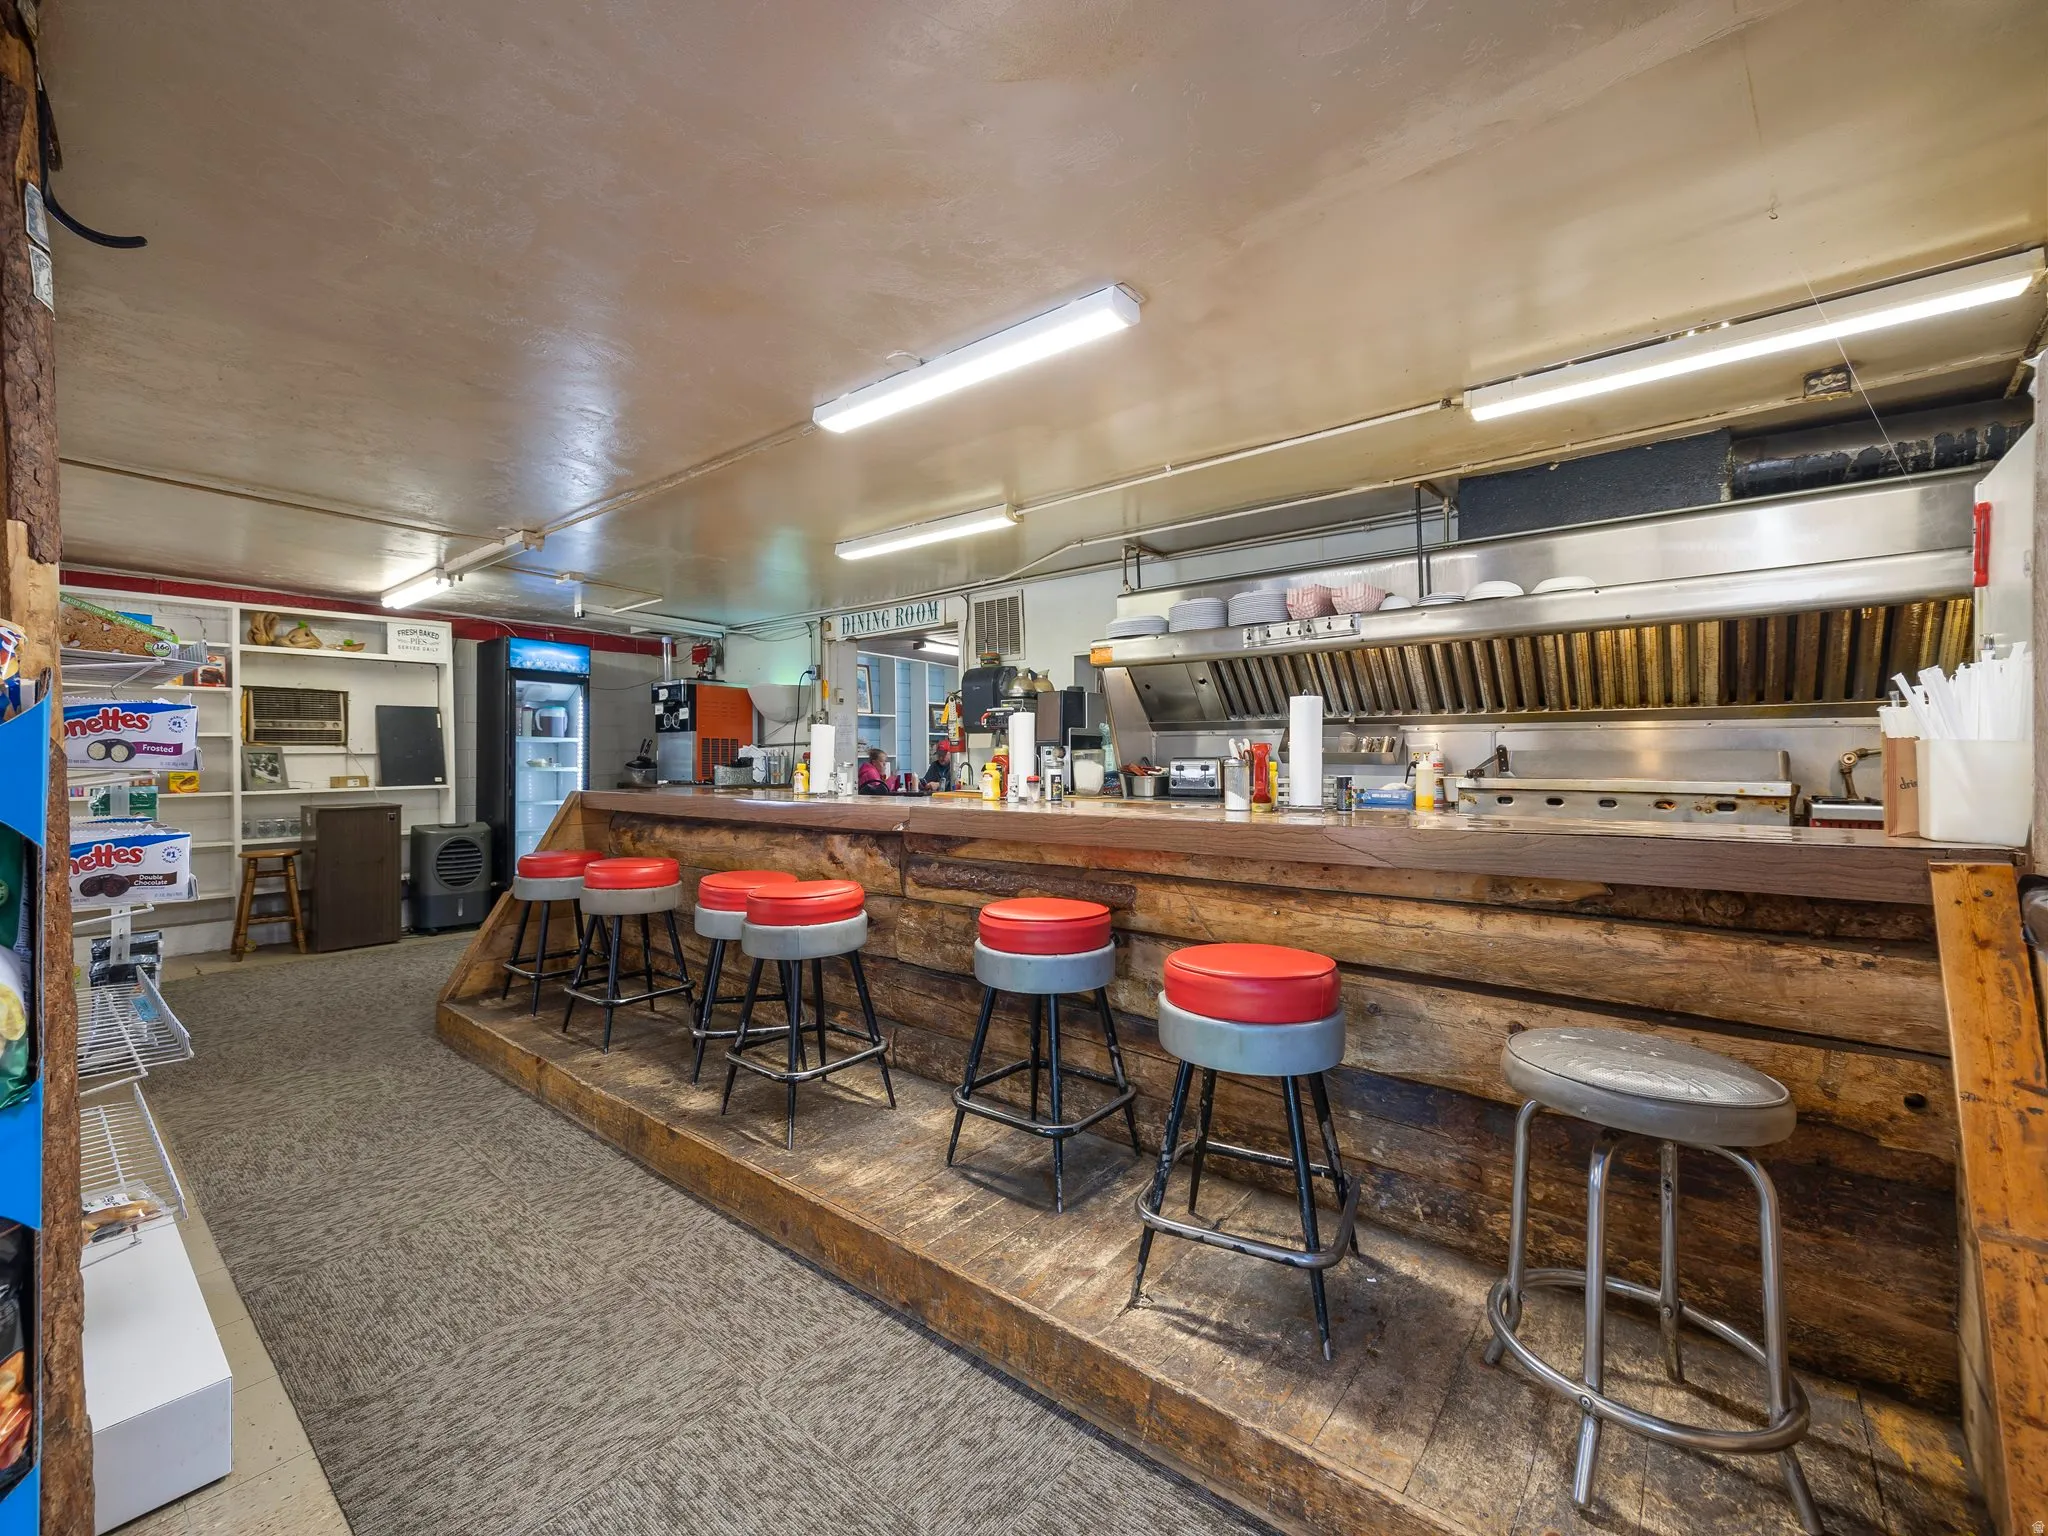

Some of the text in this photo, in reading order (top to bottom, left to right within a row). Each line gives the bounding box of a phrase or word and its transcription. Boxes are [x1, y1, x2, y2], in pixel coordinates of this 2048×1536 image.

[841, 601, 939, 635] DINING ROOM
[397, 629, 440, 640] FRESH BAKED
[172, 720, 182, 728] #1
[142, 743, 174, 754] Frosted
